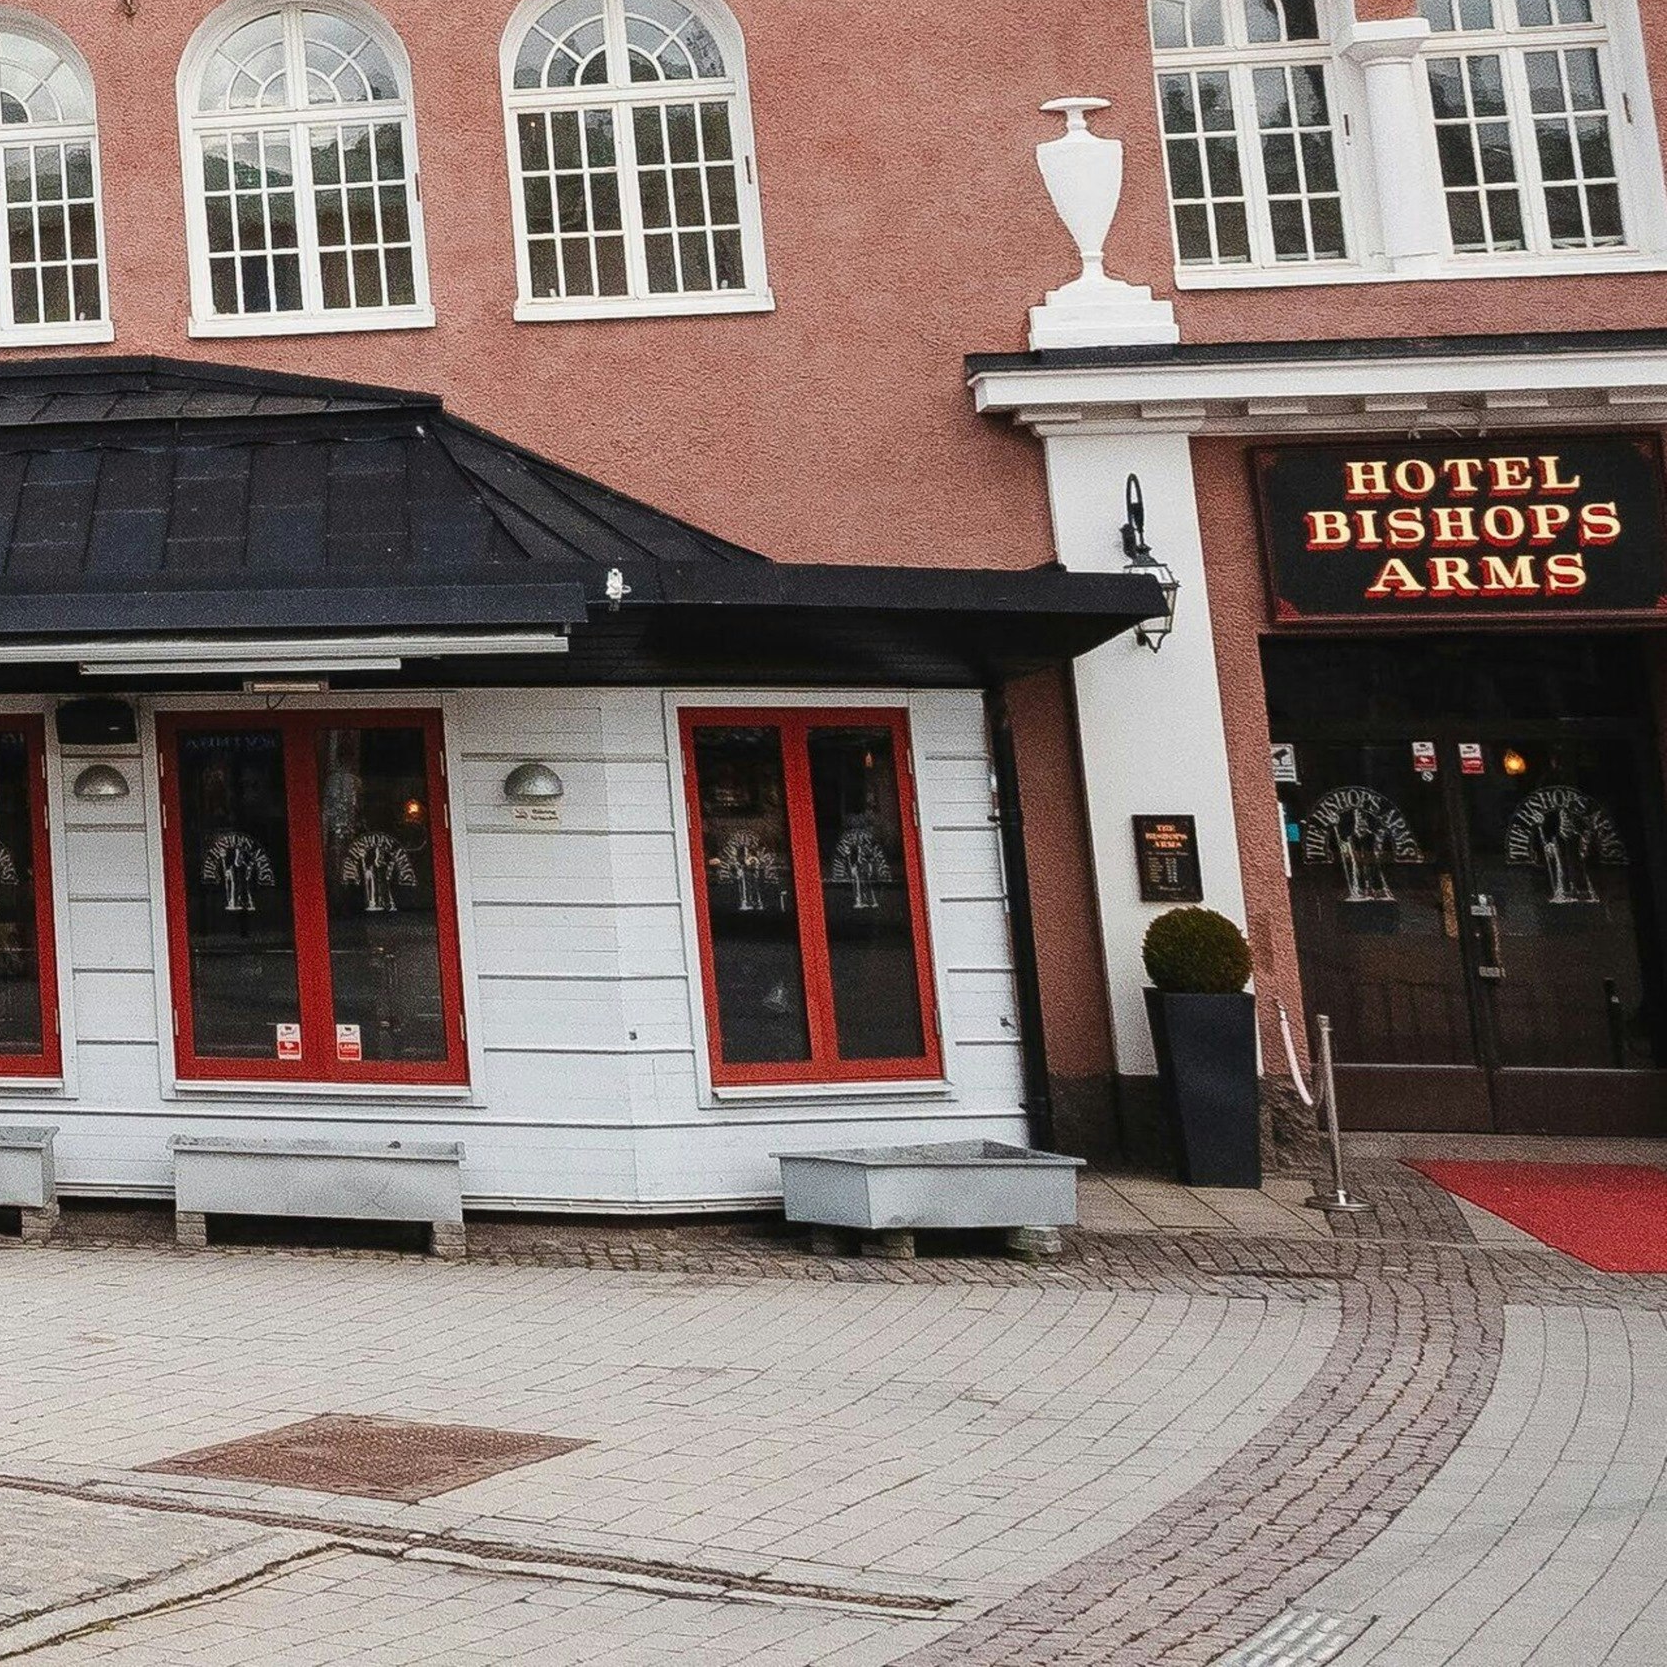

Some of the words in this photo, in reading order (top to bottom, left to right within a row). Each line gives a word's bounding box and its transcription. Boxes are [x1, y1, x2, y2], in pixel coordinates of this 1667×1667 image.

[1346, 455, 1581, 500] HOTEL
[1306, 502, 1622, 550] BISHOPS
[1366, 553, 1587, 597] ARMS
[1312, 789, 1381, 828] BISHOPS
[1517, 789, 1586, 828] BISHOPS
[1306, 823, 1328, 860] THE
[1509, 822, 1532, 860] THE
